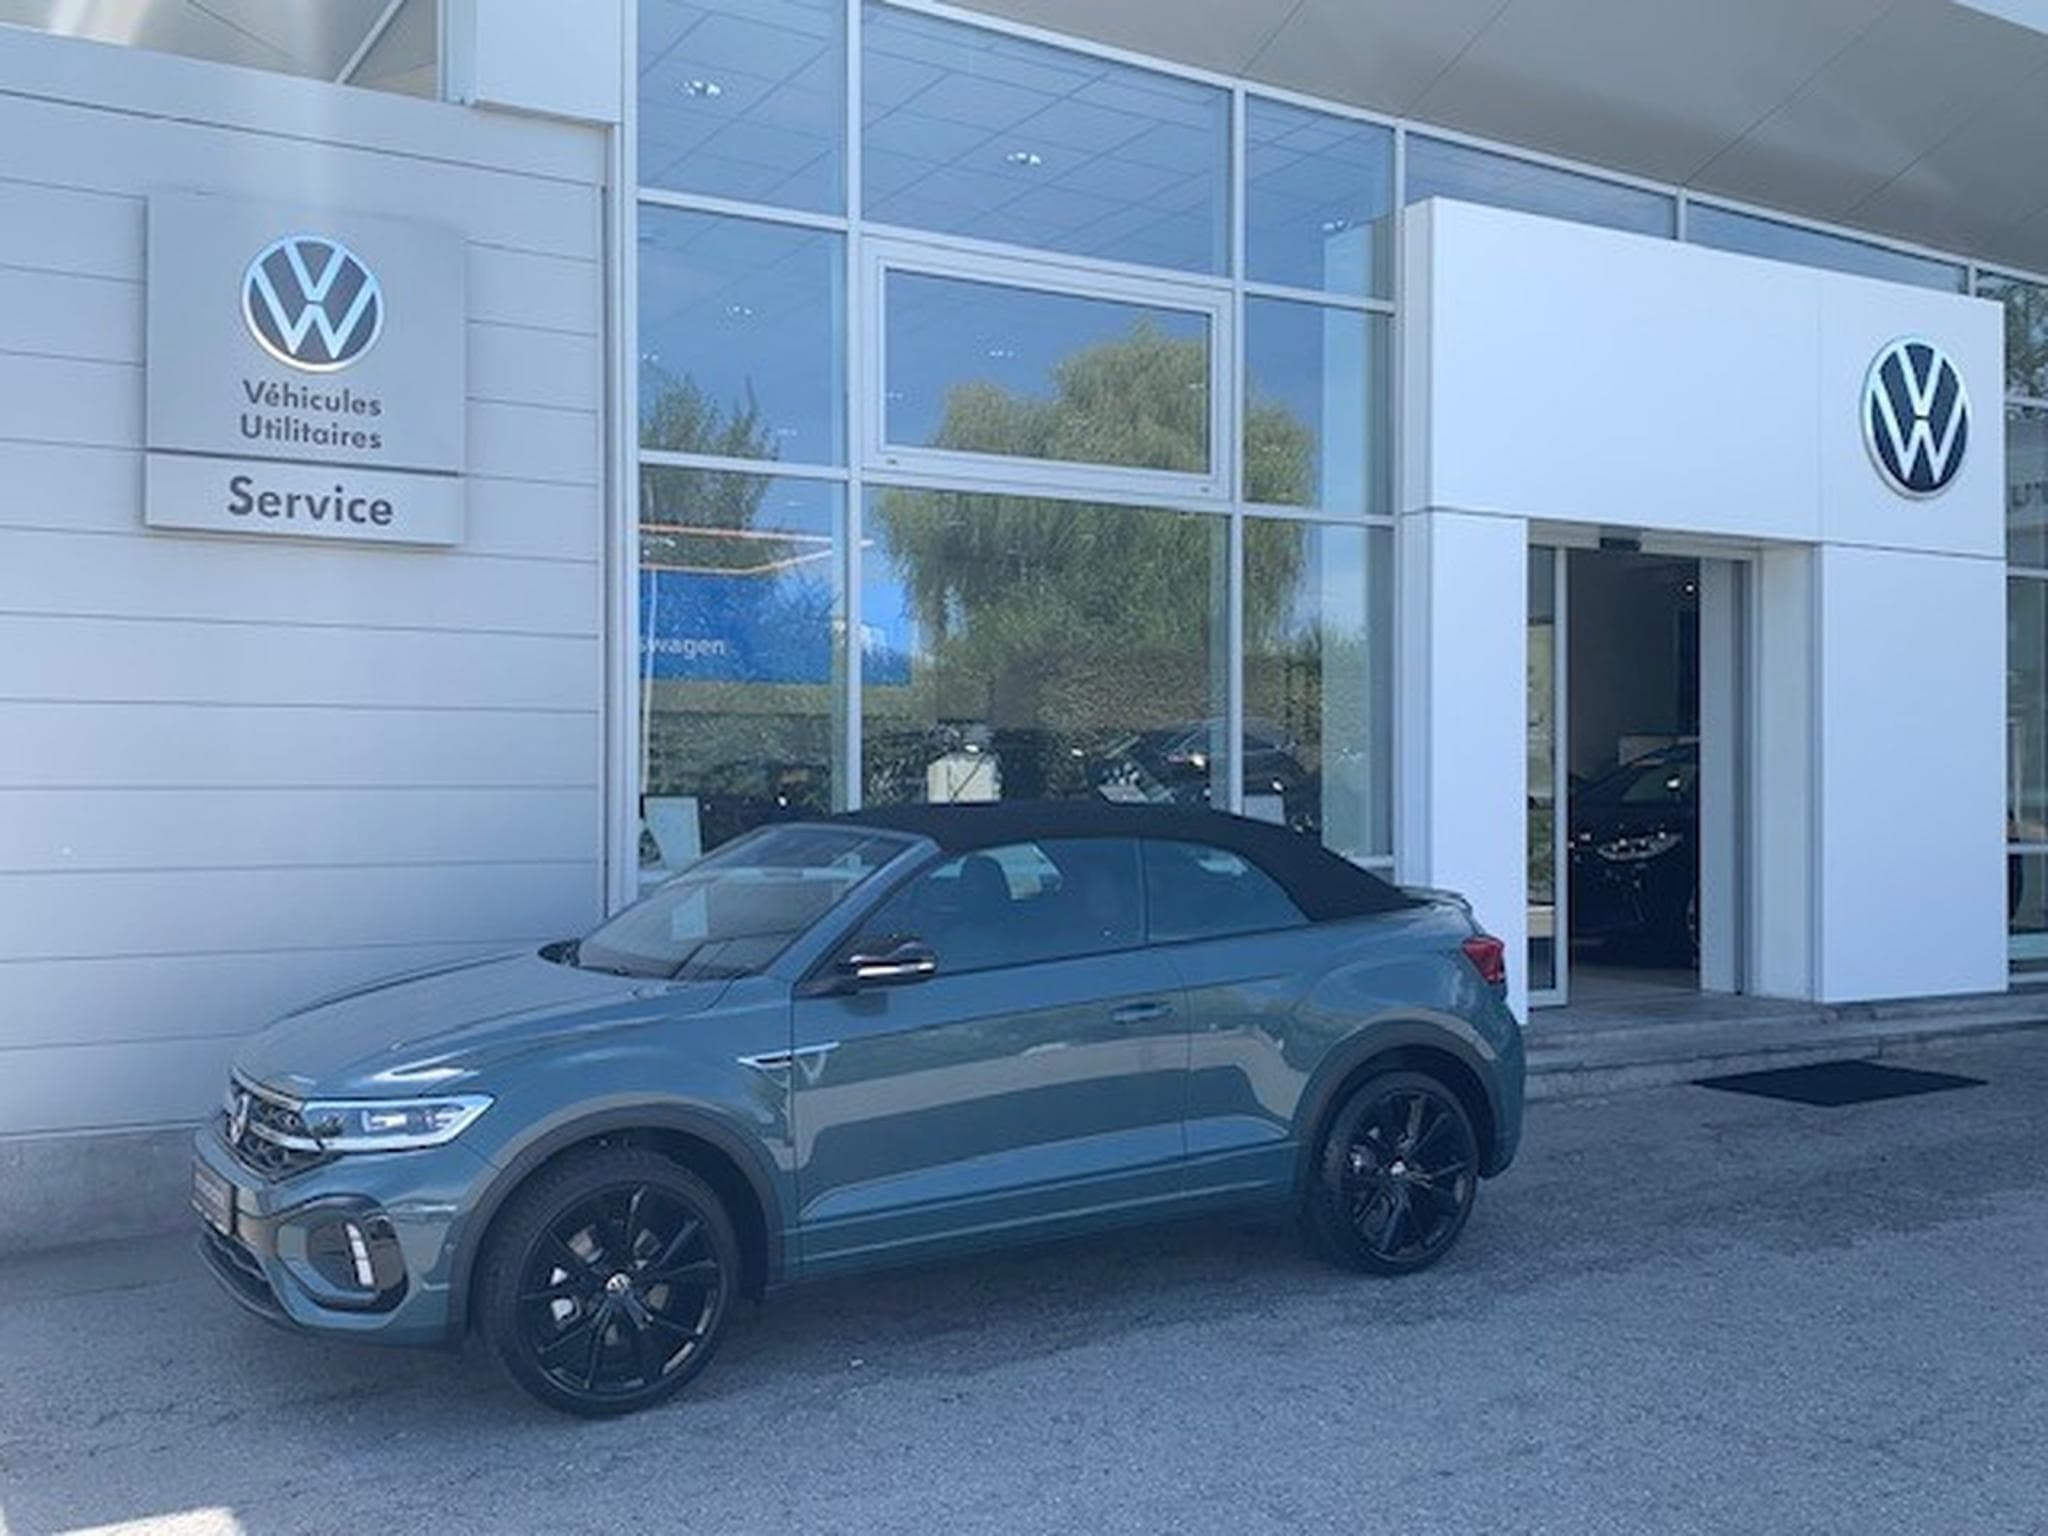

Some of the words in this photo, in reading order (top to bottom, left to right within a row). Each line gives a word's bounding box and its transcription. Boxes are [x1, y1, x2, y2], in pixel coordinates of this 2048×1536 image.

[243, 379, 382, 417] Véhicules
[1868, 344, 1965, 486] VW
[240, 413, 382, 449] Utilitaires
[227, 475, 393, 526] Service
